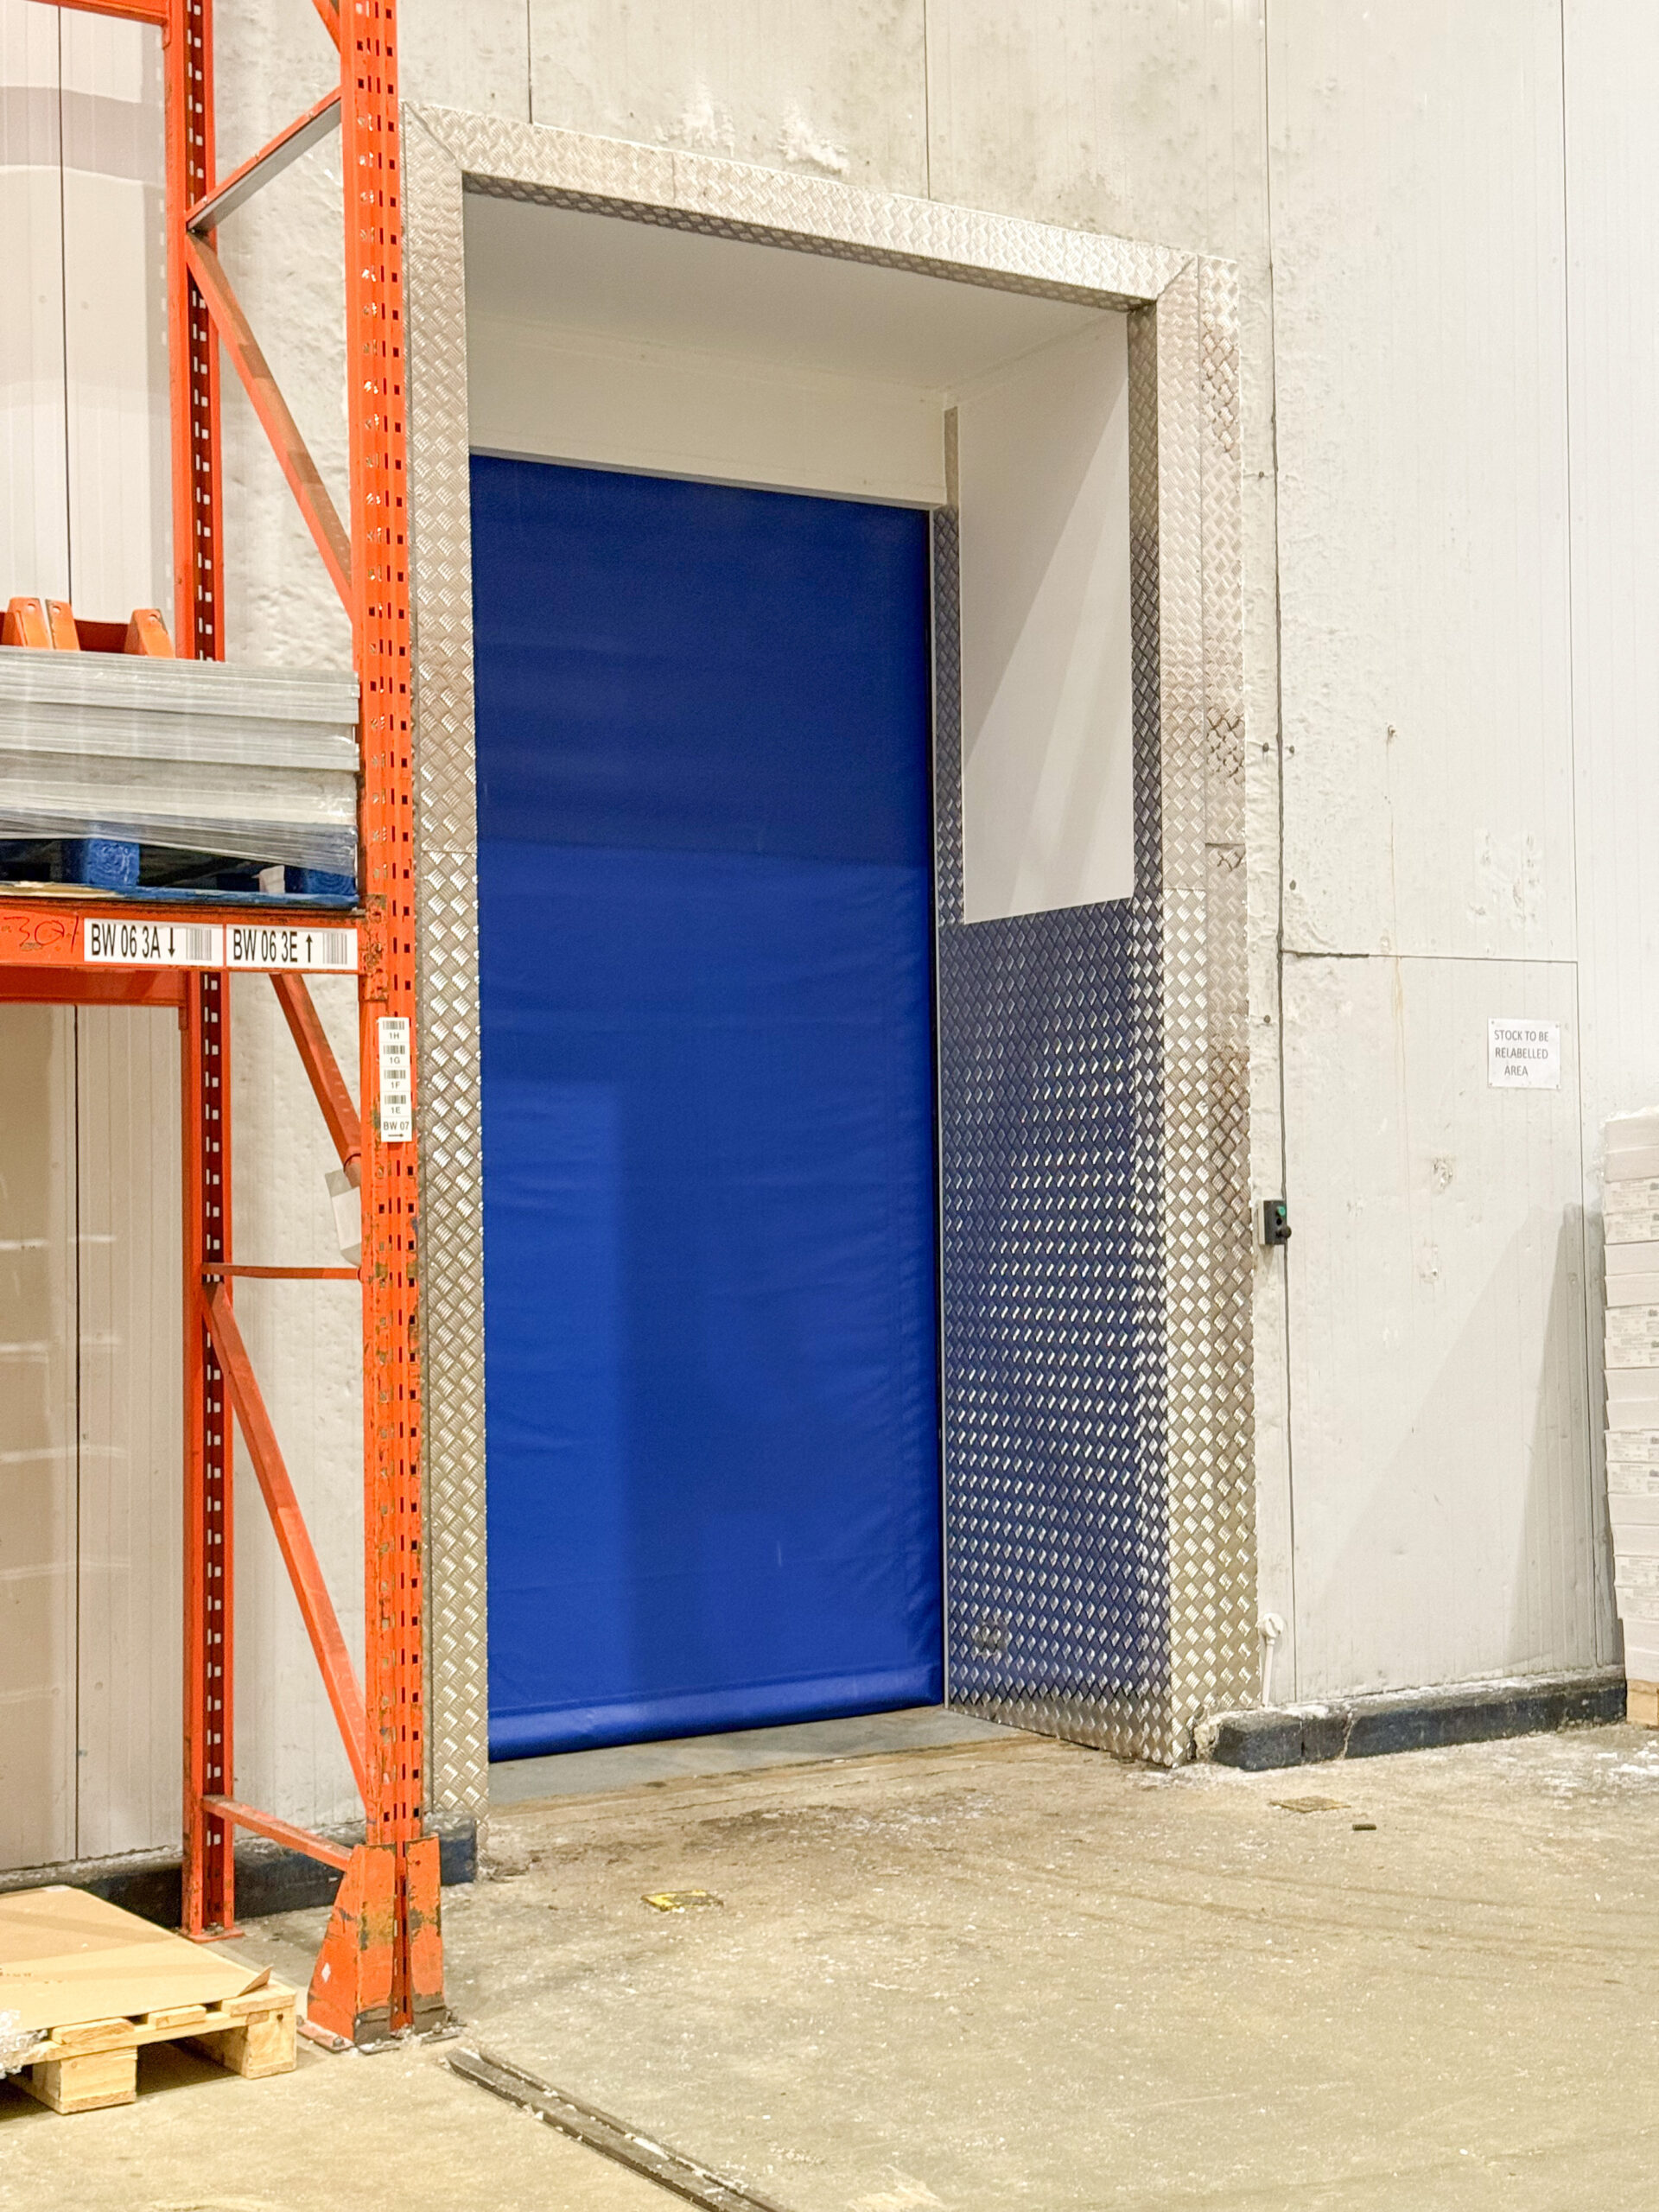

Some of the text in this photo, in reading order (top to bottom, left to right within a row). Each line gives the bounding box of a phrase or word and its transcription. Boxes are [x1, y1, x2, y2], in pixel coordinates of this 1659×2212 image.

[92, 924, 161, 958] BW 06 3A
[233, 929, 297, 963] BW 06 3E
[1494, 1030, 1549, 1042] STOCK TO BE
[1495, 1047, 1548, 1059] RELABELLED
[1503, 1065, 1529, 1077] AREA
[383, 1122, 410, 1130] BW 07
